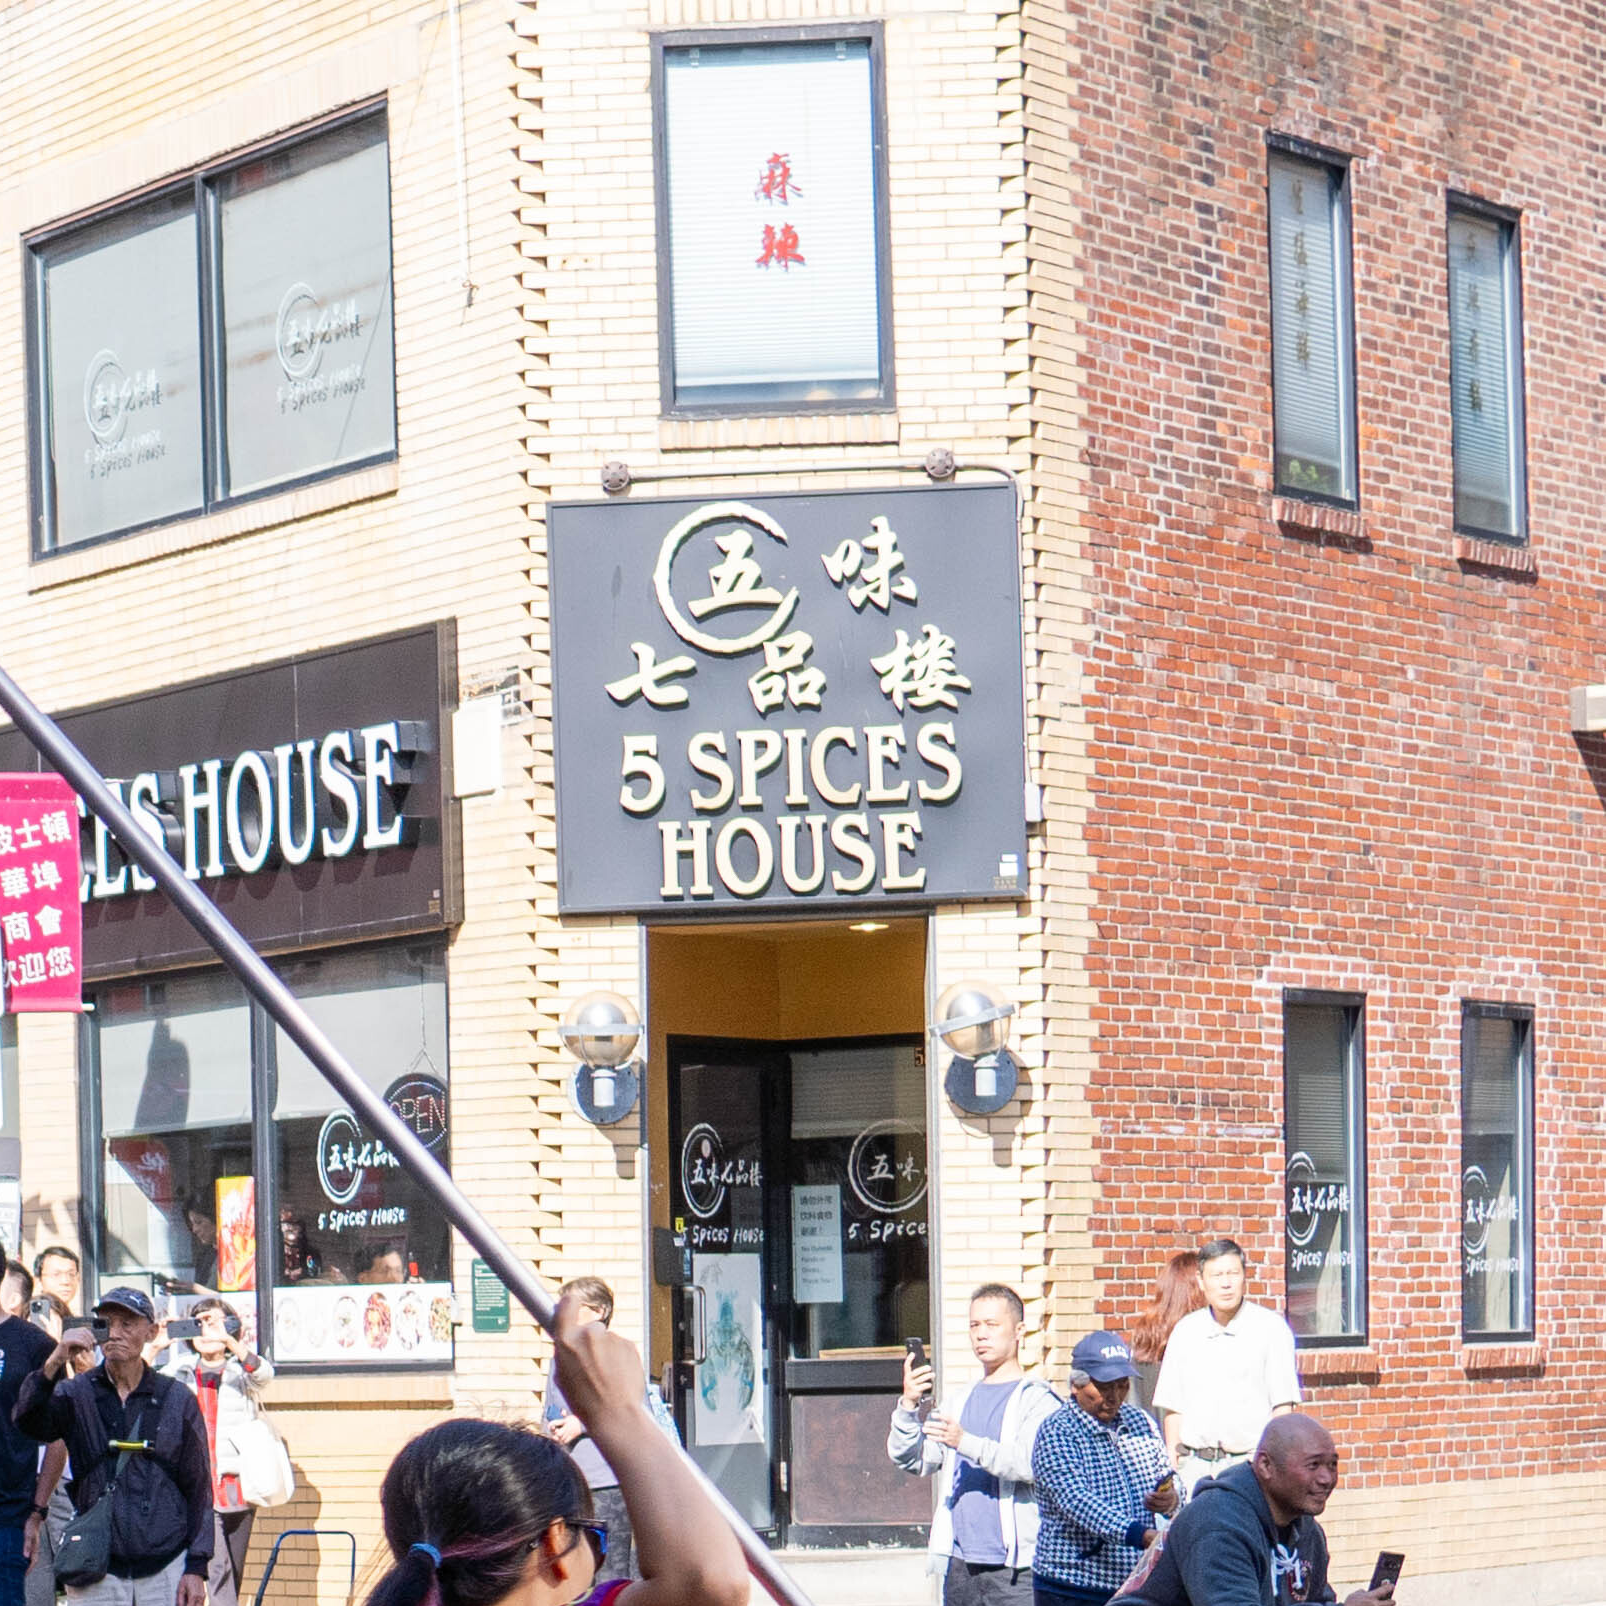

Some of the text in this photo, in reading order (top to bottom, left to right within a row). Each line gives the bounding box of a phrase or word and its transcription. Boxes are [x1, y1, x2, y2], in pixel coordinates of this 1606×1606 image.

[687, 515, 919, 619] 五味
[619, 721, 964, 813] 5 SPICES
[179, 720, 405, 881] HOUSE
[658, 810, 926, 899] HOUSE
[0, 861, 63, 899] 華埠
[2, 905, 64, 944] 商會
[317, 1205, 407, 1232] 5 Spices House
[692, 1225, 729, 1247] Spices
[733, 1228, 765, 1244] House
[848, 1222, 861, 1240] 5
[1291, 1249, 1323, 1272] Spices
[1466, 1256, 1492, 1277] Spices
